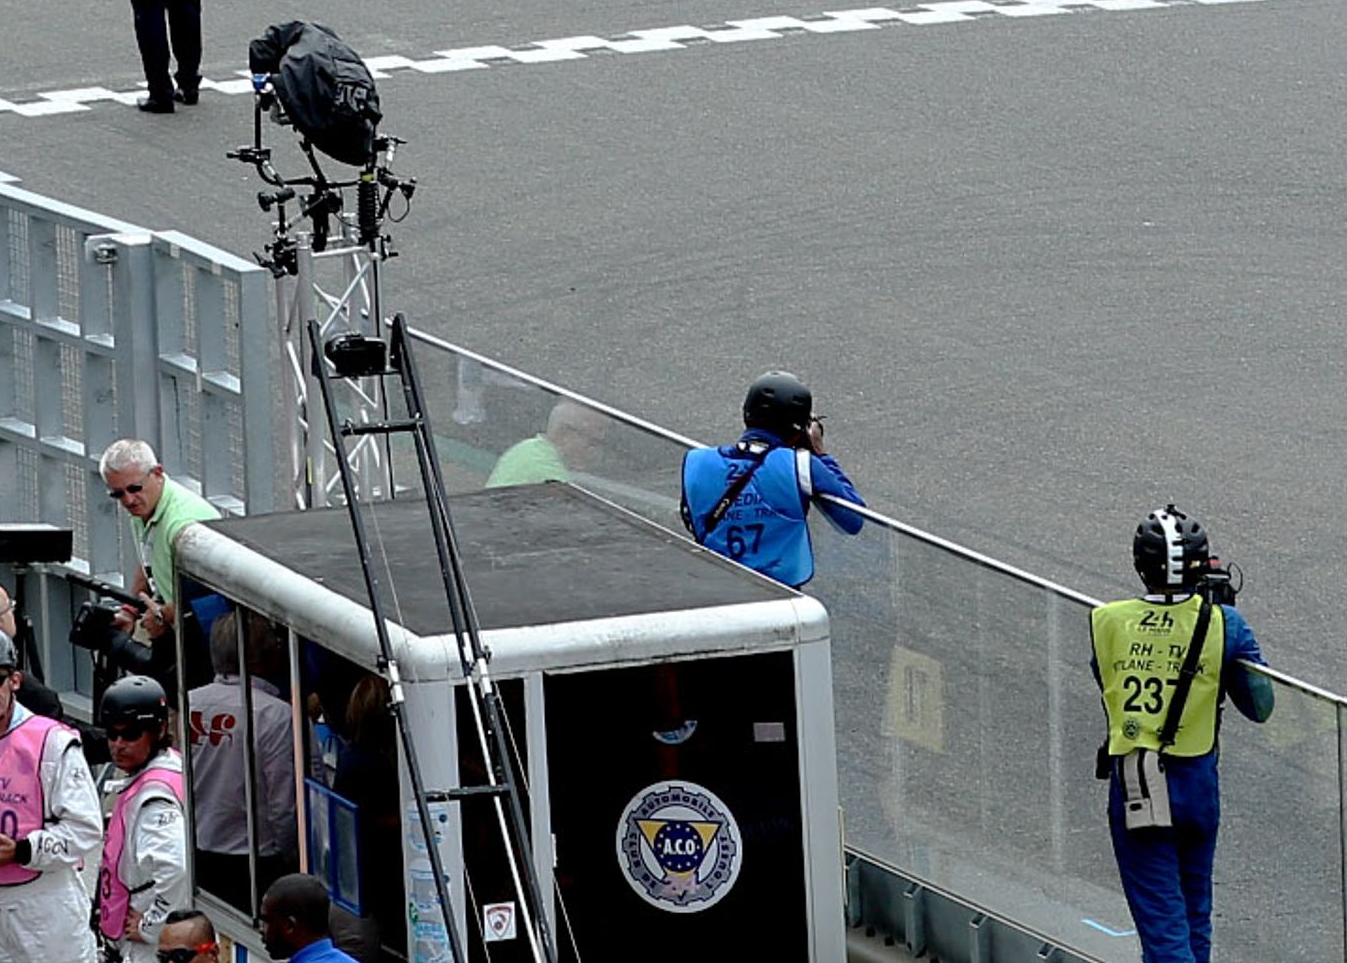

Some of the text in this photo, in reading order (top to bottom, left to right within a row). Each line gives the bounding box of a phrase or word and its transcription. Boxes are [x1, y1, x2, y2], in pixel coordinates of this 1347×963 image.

[727, 523, 764, 559] 67
[1129, 643, 1153, 656] RH
[1168, 645, 1187, 657] TV
[641, 793, 715, 817] AUTOMOBILE
